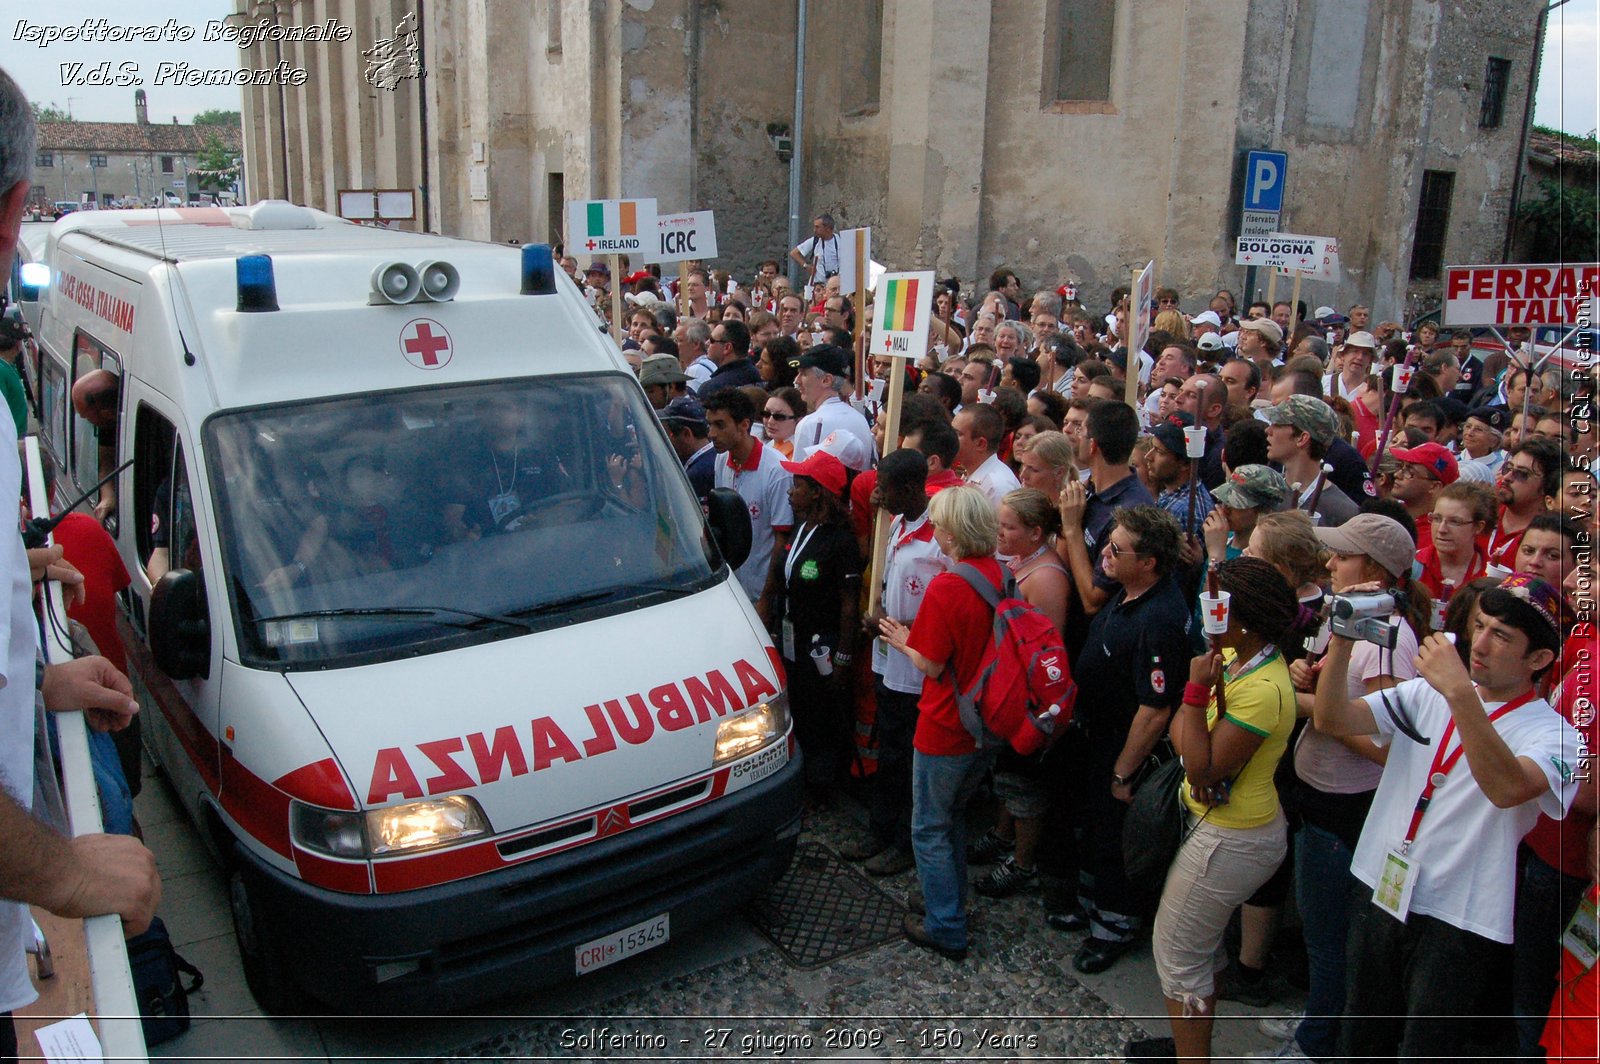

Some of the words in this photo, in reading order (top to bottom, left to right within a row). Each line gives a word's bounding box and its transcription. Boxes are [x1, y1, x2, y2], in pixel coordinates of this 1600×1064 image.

[1252, 159, 1277, 204] P
[1246, 214, 1276, 224] riservato
[598, 238, 640, 249] IRELAND
[660, 230, 697, 254] ICRC
[1239, 243, 1313, 255] BOLOGNA
[96, 290, 134, 334] ITALIANA
[1496, 300, 1587, 323] ITALY
[892, 337, 908, 351] MALI
[581, 945, 605, 968] CRI
[619, 921, 665, 953] 15345
